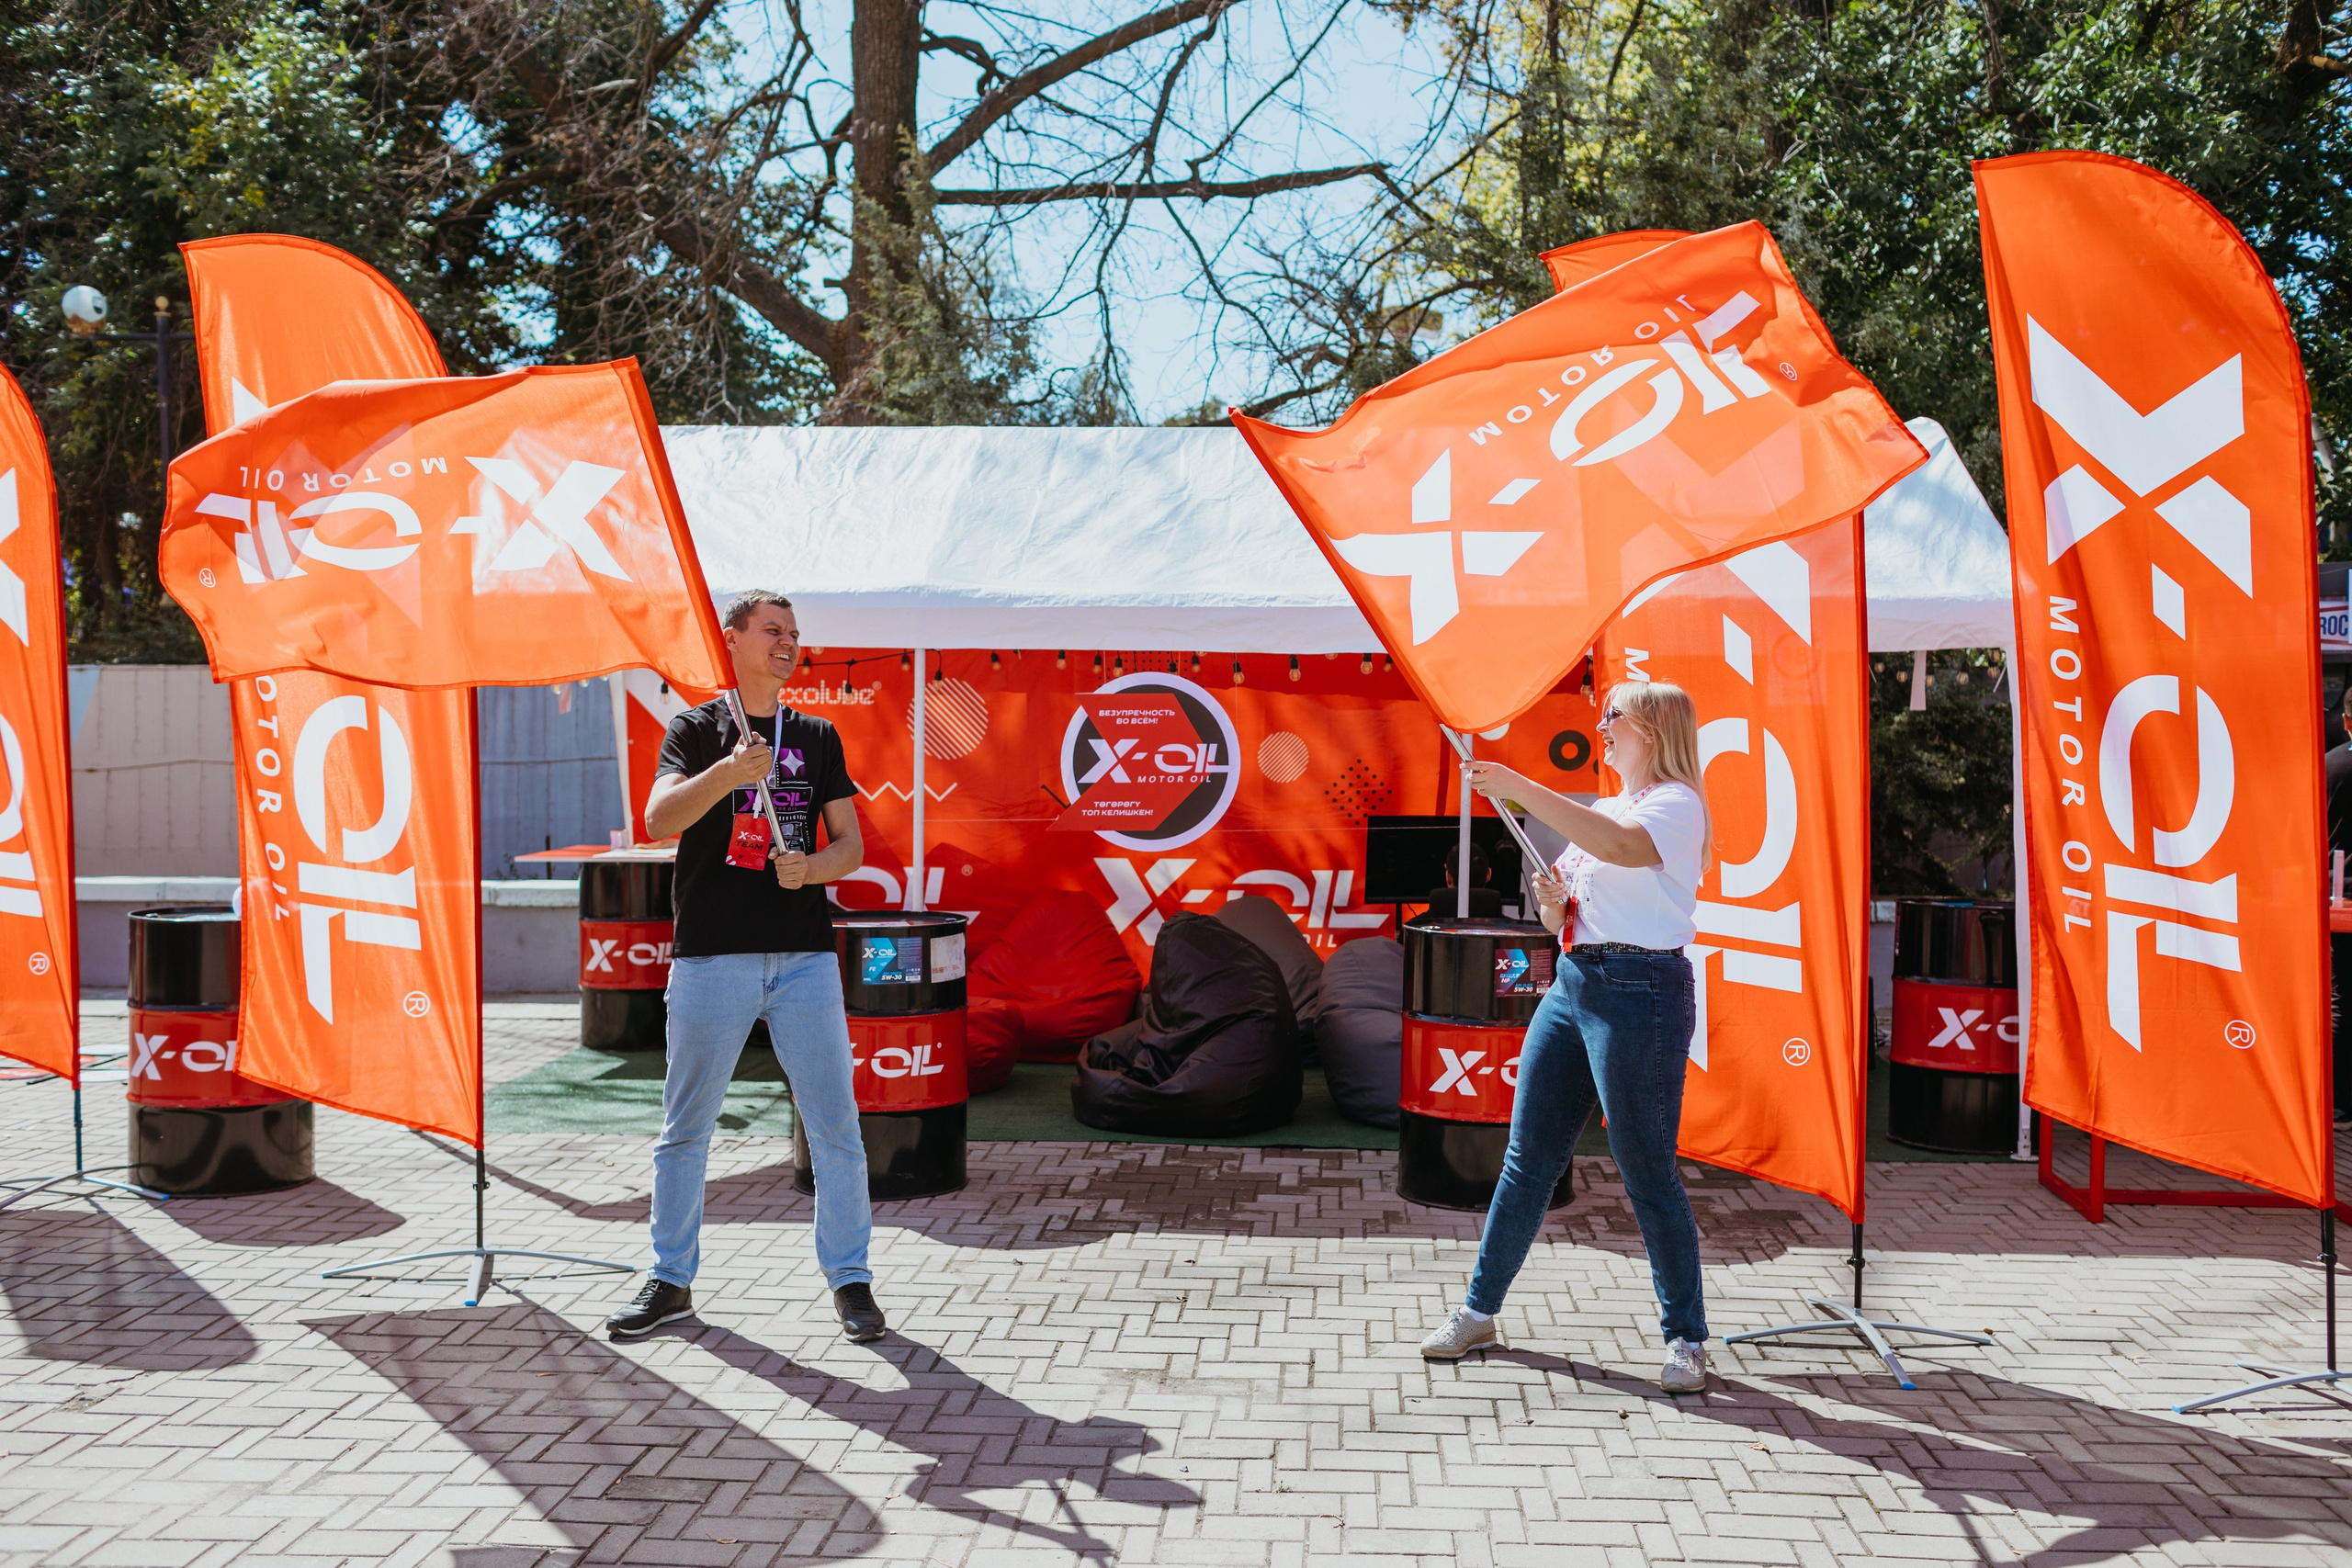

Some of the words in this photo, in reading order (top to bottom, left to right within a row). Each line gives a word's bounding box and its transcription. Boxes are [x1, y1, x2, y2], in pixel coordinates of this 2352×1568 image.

[239, 466, 284, 491] OIL
[302, 457, 448, 492] MOTOR
[195, 456, 633, 584] X-OIL
[777, 680, 875, 705] exolube
[2027, 312, 2254, 1054] X-OIL
[1098, 709, 1176, 717] БЕЗУПРЕЧНОСТЬ
[2047, 595, 2086, 807] MOTOR
[1130, 716, 1159, 725] ВСЁМ!
[254, 675, 282, 815] OTOR
[1077, 739, 1231, 784] X-OIL
[1137, 775, 1184, 784] MOTOR
[1190, 775, 1212, 784] OIL
[1101, 808, 1154, 817] КЕЛИШКЕН!
[736, 840, 763, 851] TEAM
[738, 830, 764, 842] X-OIL
[293, 694, 422, 1025] OIL
[265, 841, 290, 922] OIL
[2062, 840, 2093, 934] OIL
[862, 947, 898, 959] X-OIL
[1495, 958, 1530, 970] X-OIL
[130, 1032, 237, 1081] X-OI
[850, 1043, 945, 1078] -OIL
